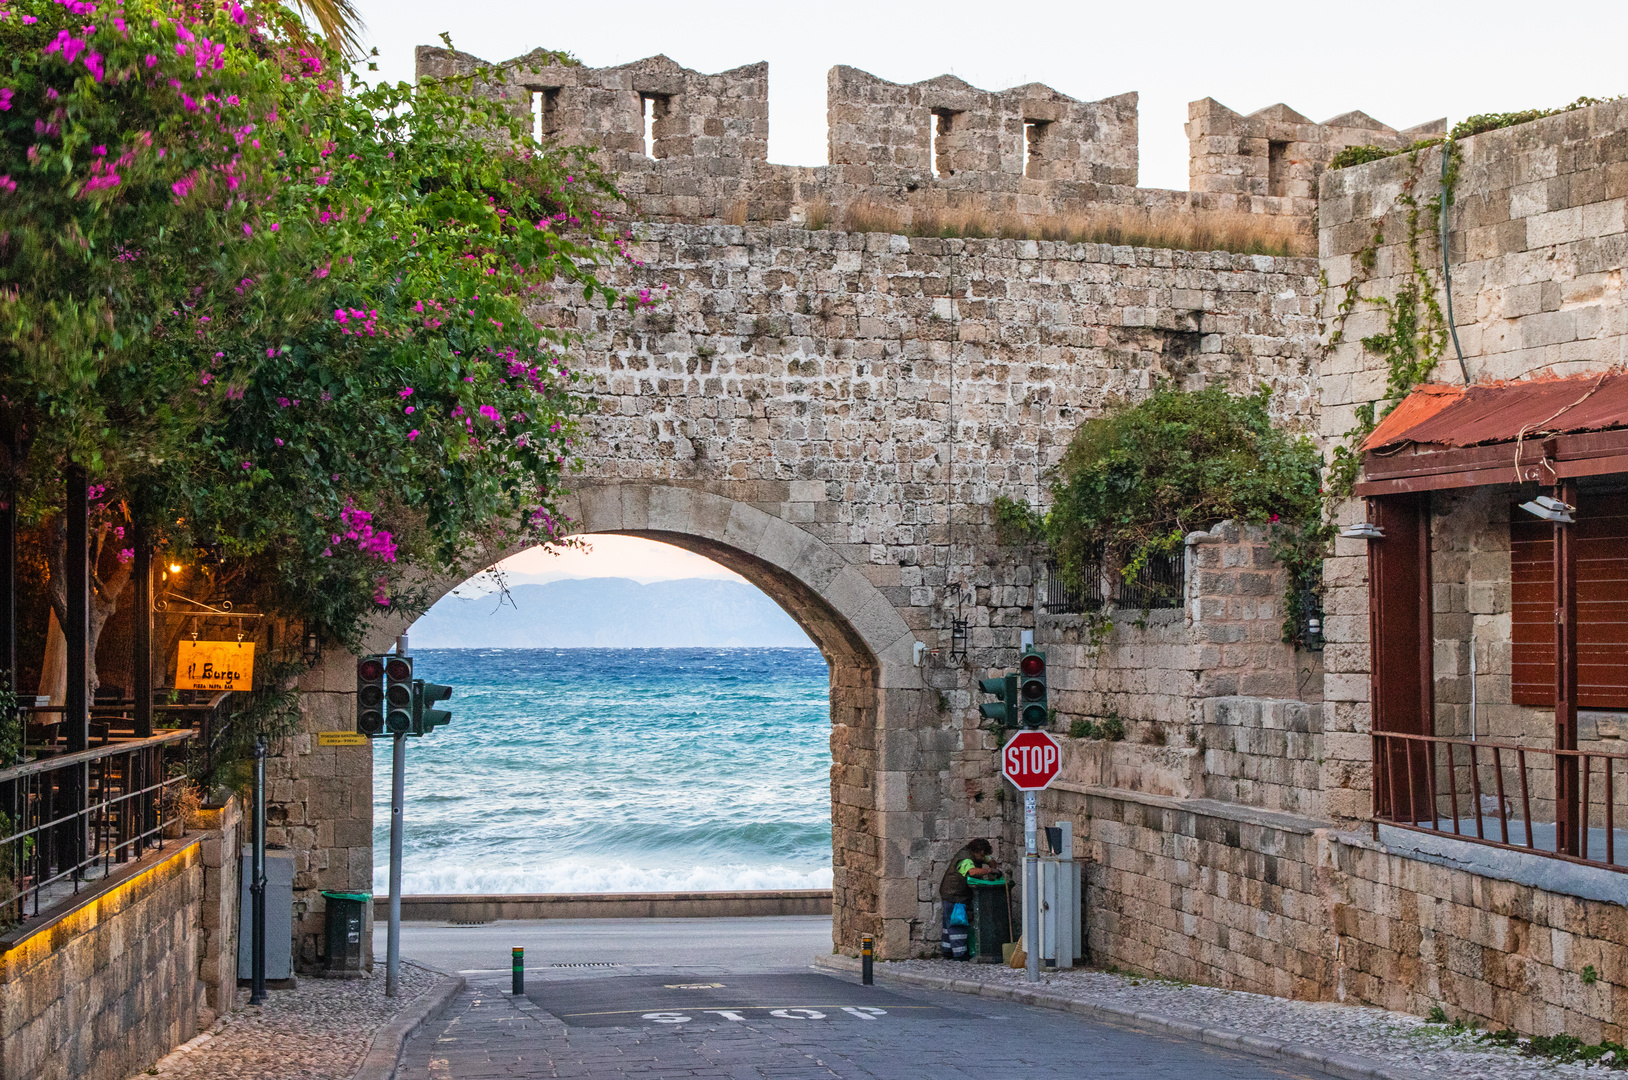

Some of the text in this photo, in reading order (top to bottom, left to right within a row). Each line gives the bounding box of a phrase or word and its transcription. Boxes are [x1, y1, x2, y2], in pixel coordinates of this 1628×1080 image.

[202, 663, 240, 684] Borgo
[1008, 745, 1056, 775] STOP
[641, 1007, 888, 1023] STOP
